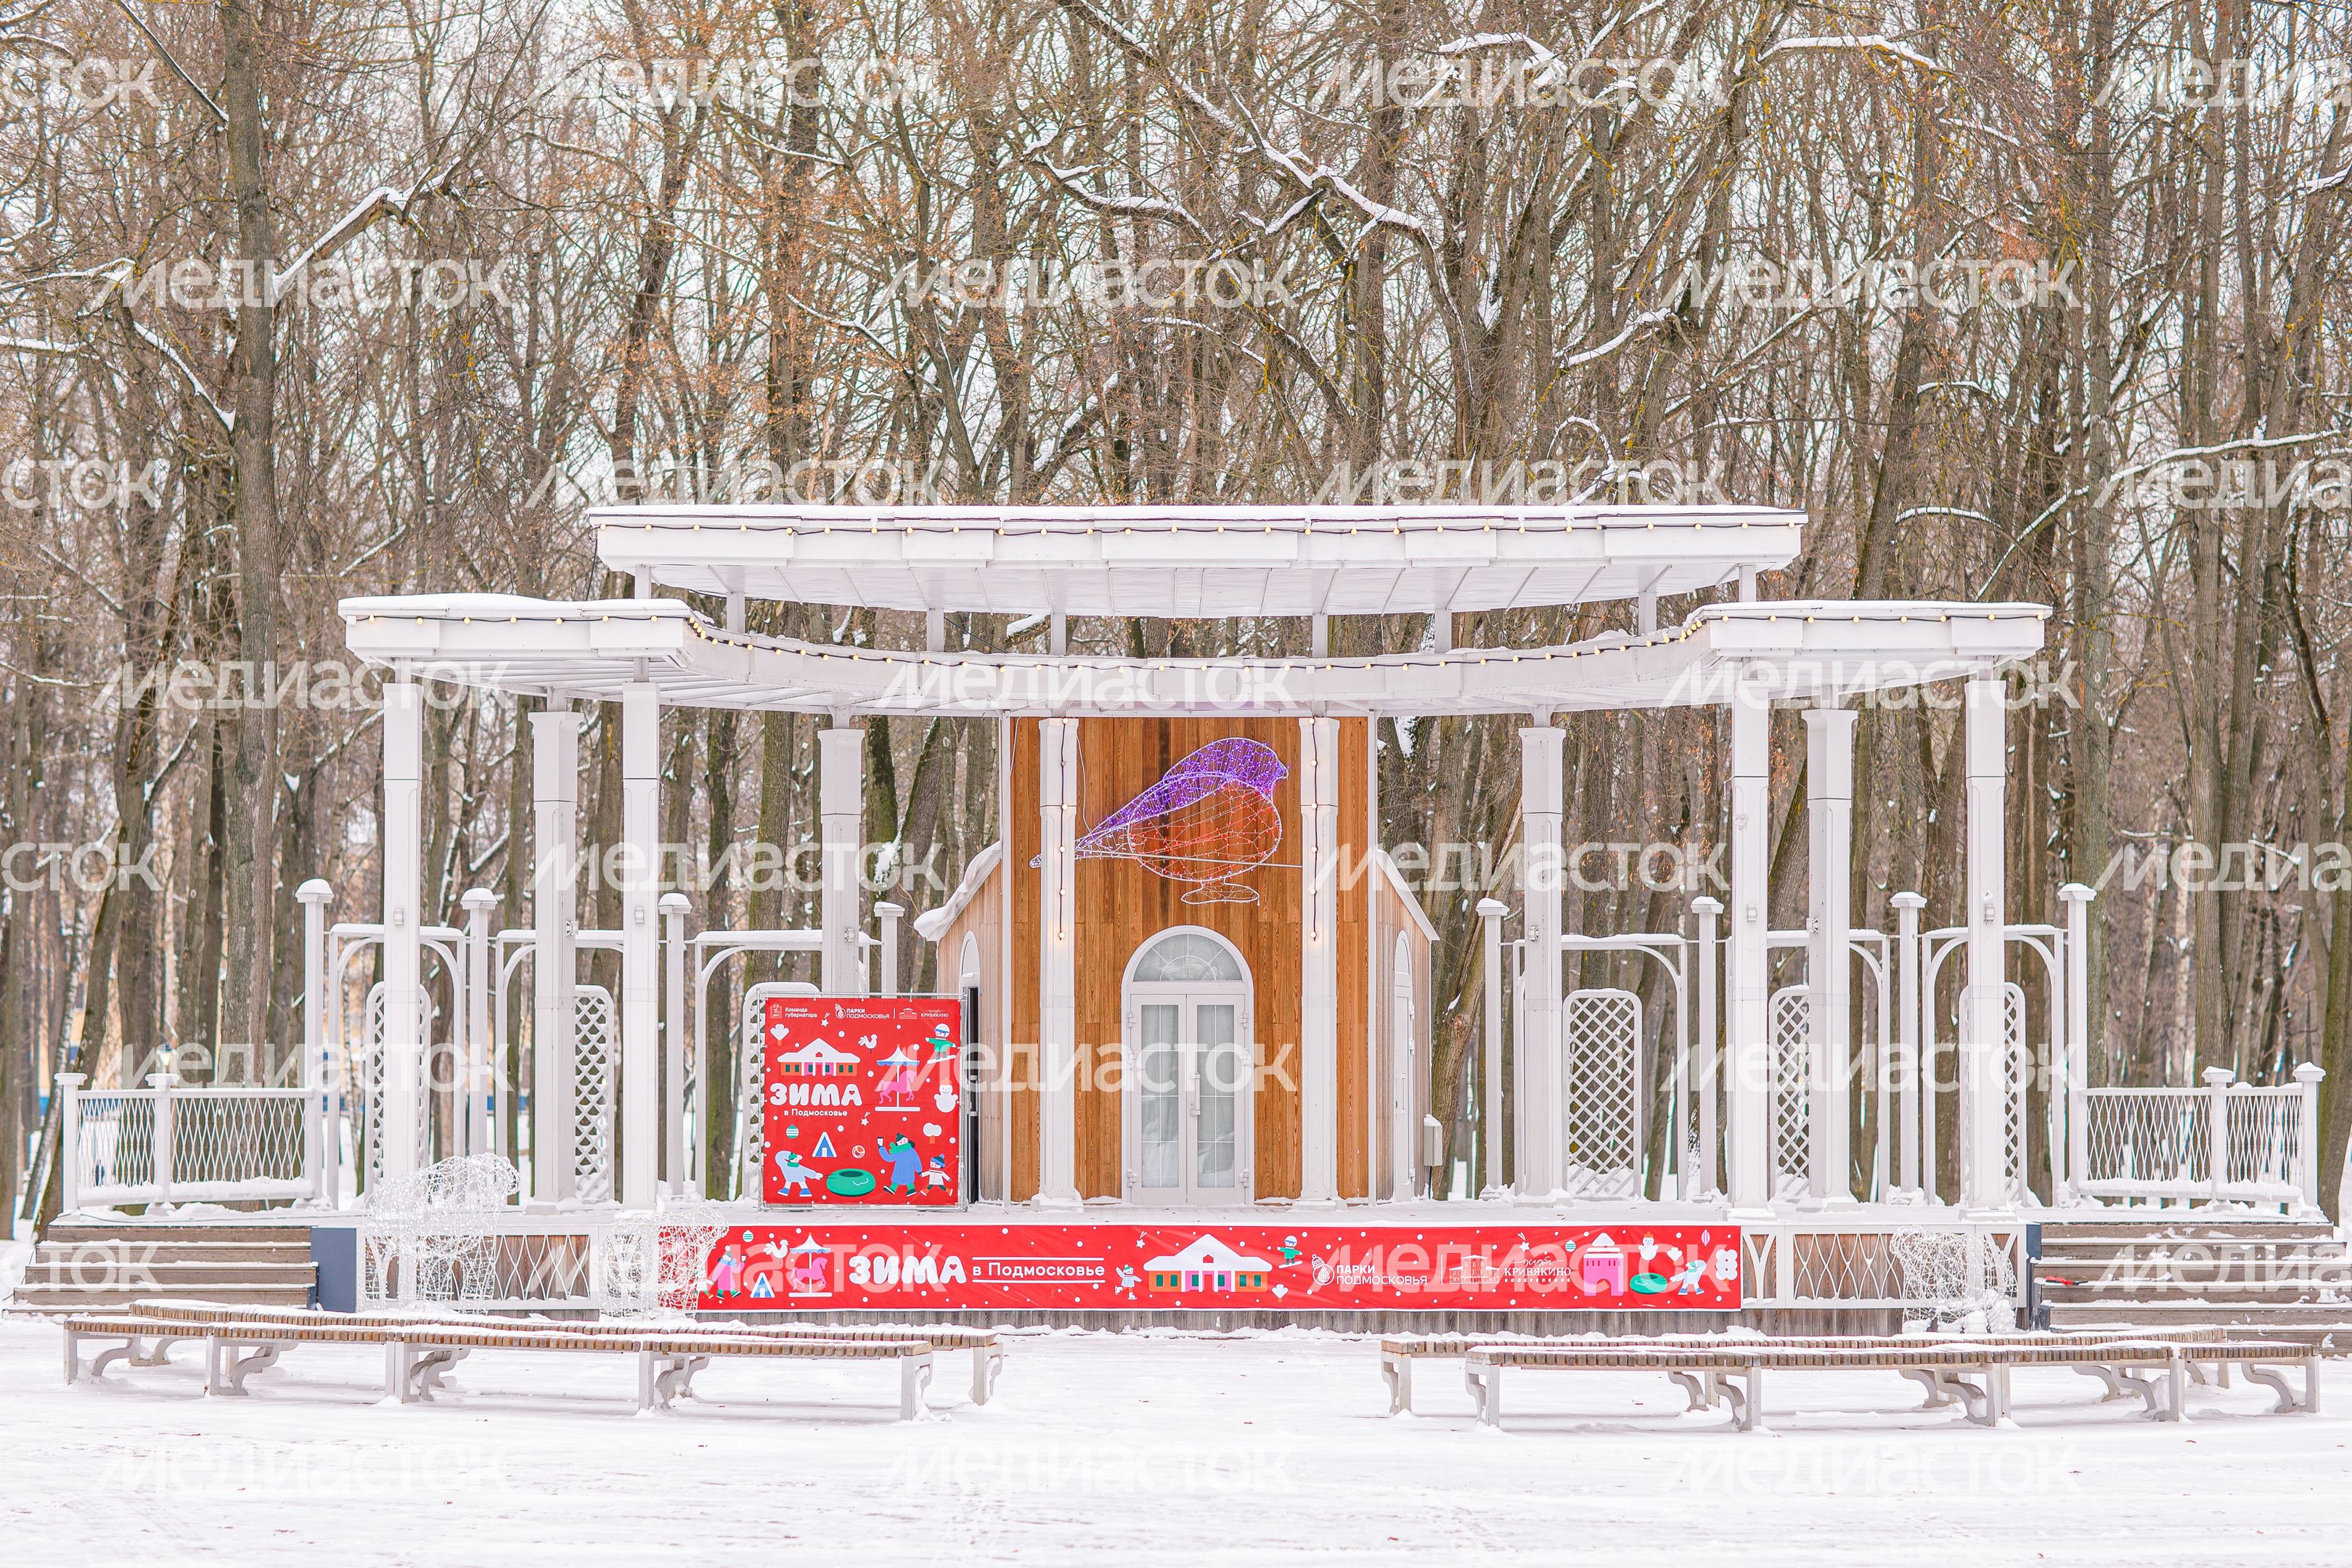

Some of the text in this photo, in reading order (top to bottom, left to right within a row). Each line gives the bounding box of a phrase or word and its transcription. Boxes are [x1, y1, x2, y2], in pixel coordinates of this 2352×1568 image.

[769, 1082, 862, 1106] ЗИМА
[849, 1255, 968, 1285] ЗИМА
[973, 1262, 1105, 1278] в Подмосковье
[1336, 1265, 1376, 1274] ПАРКИ
[1504, 1267, 1572, 1276] КРИВЯКИНО
